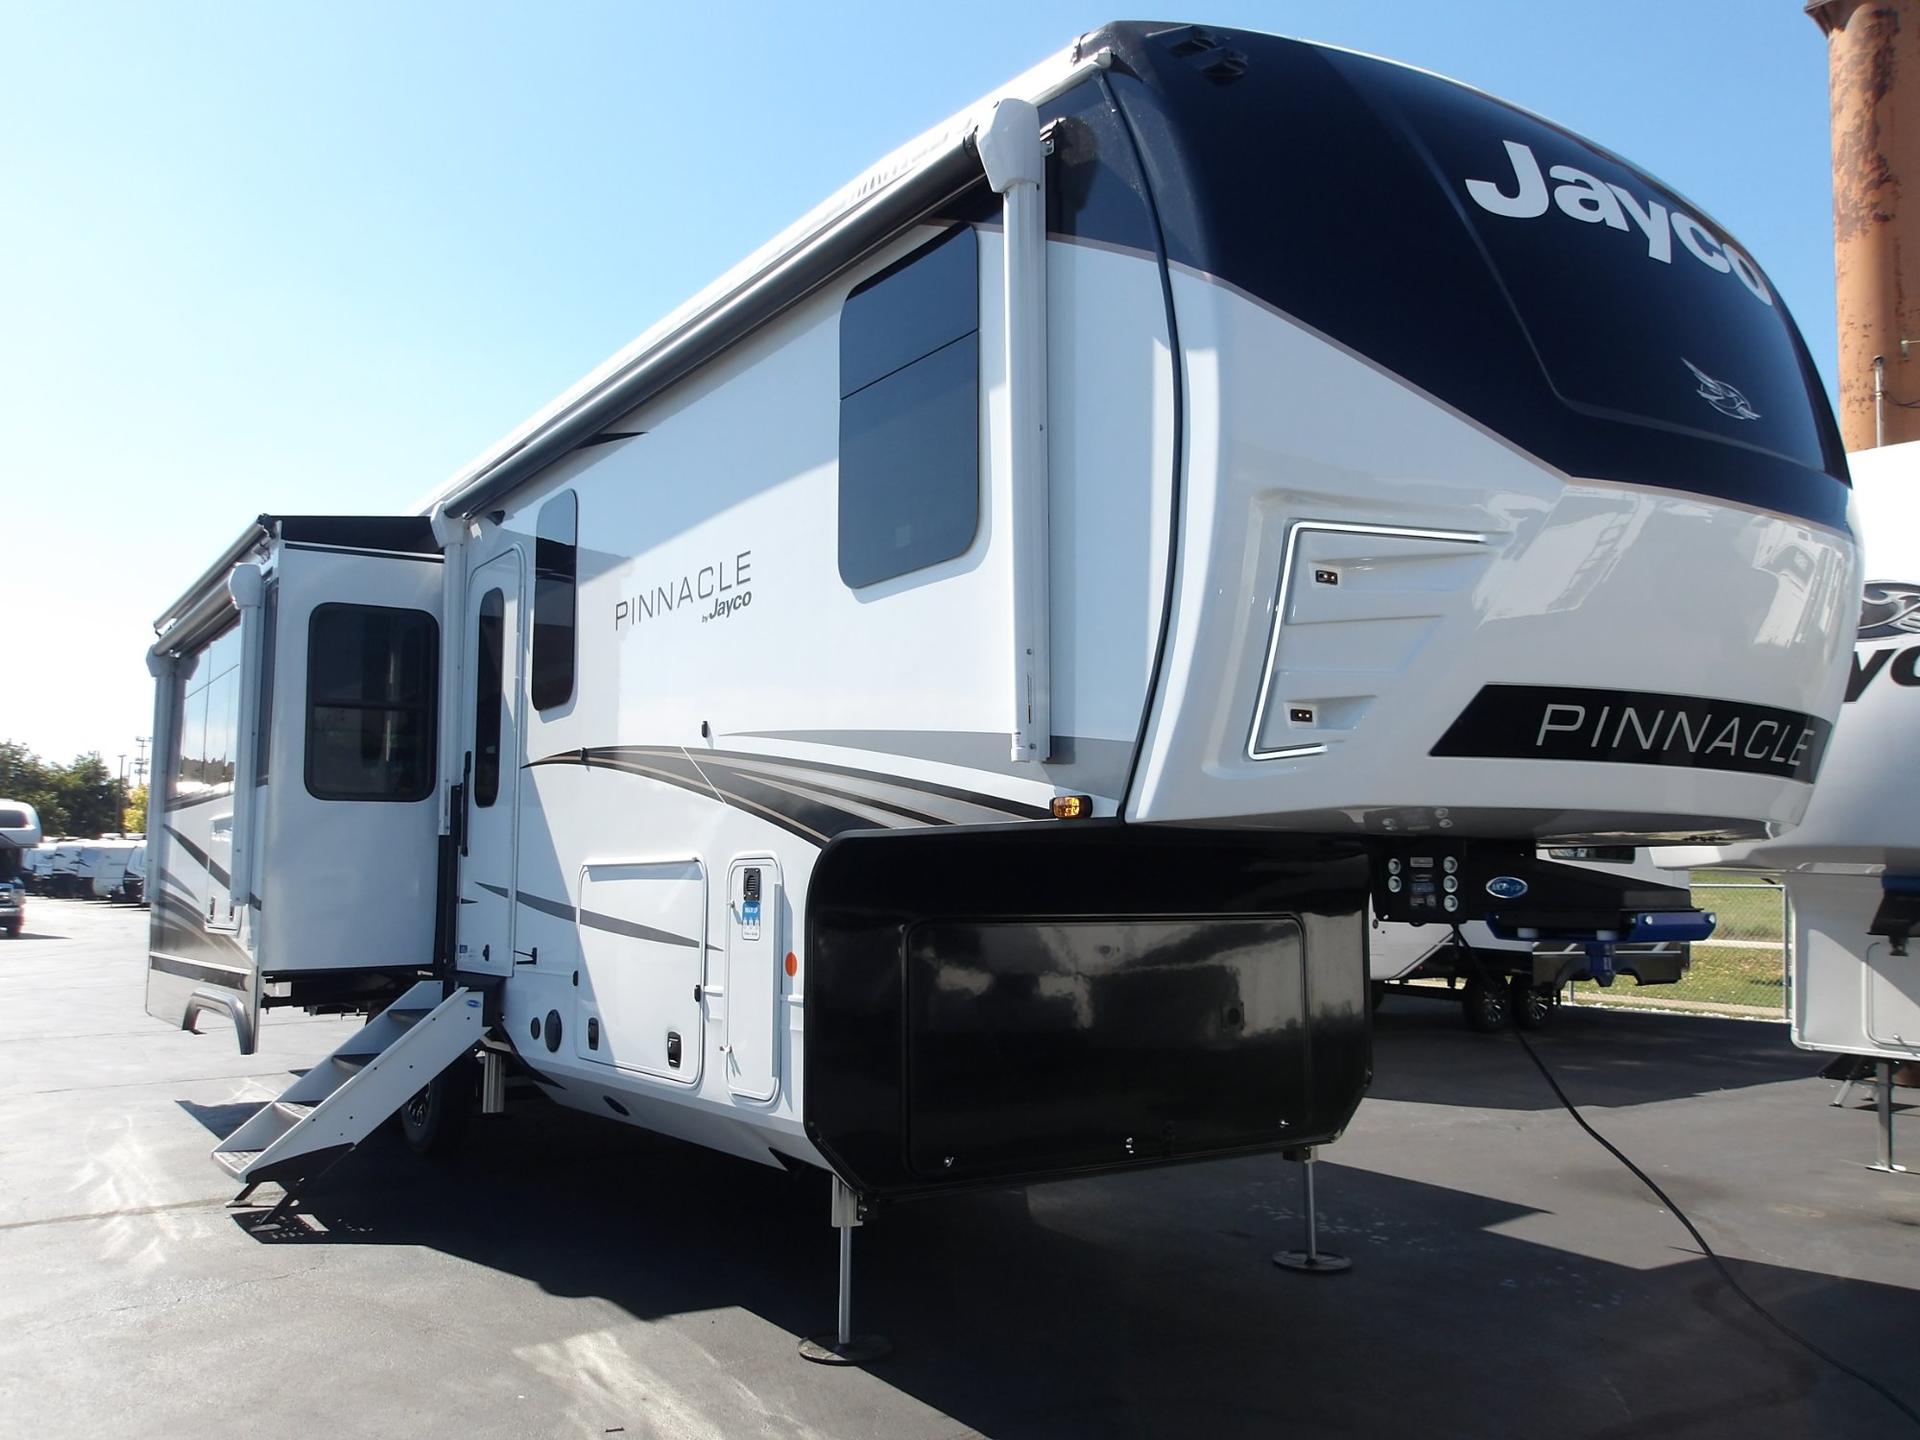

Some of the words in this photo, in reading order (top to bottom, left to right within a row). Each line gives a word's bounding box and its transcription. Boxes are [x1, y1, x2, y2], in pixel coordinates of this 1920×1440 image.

[1465, 140, 1773, 306] Jayco
[615, 550, 752, 632] PINNACLE
[701, 614, 709, 624] by
[709, 590, 752, 620] Jayco
[1536, 703, 1817, 767] PINNACLE
